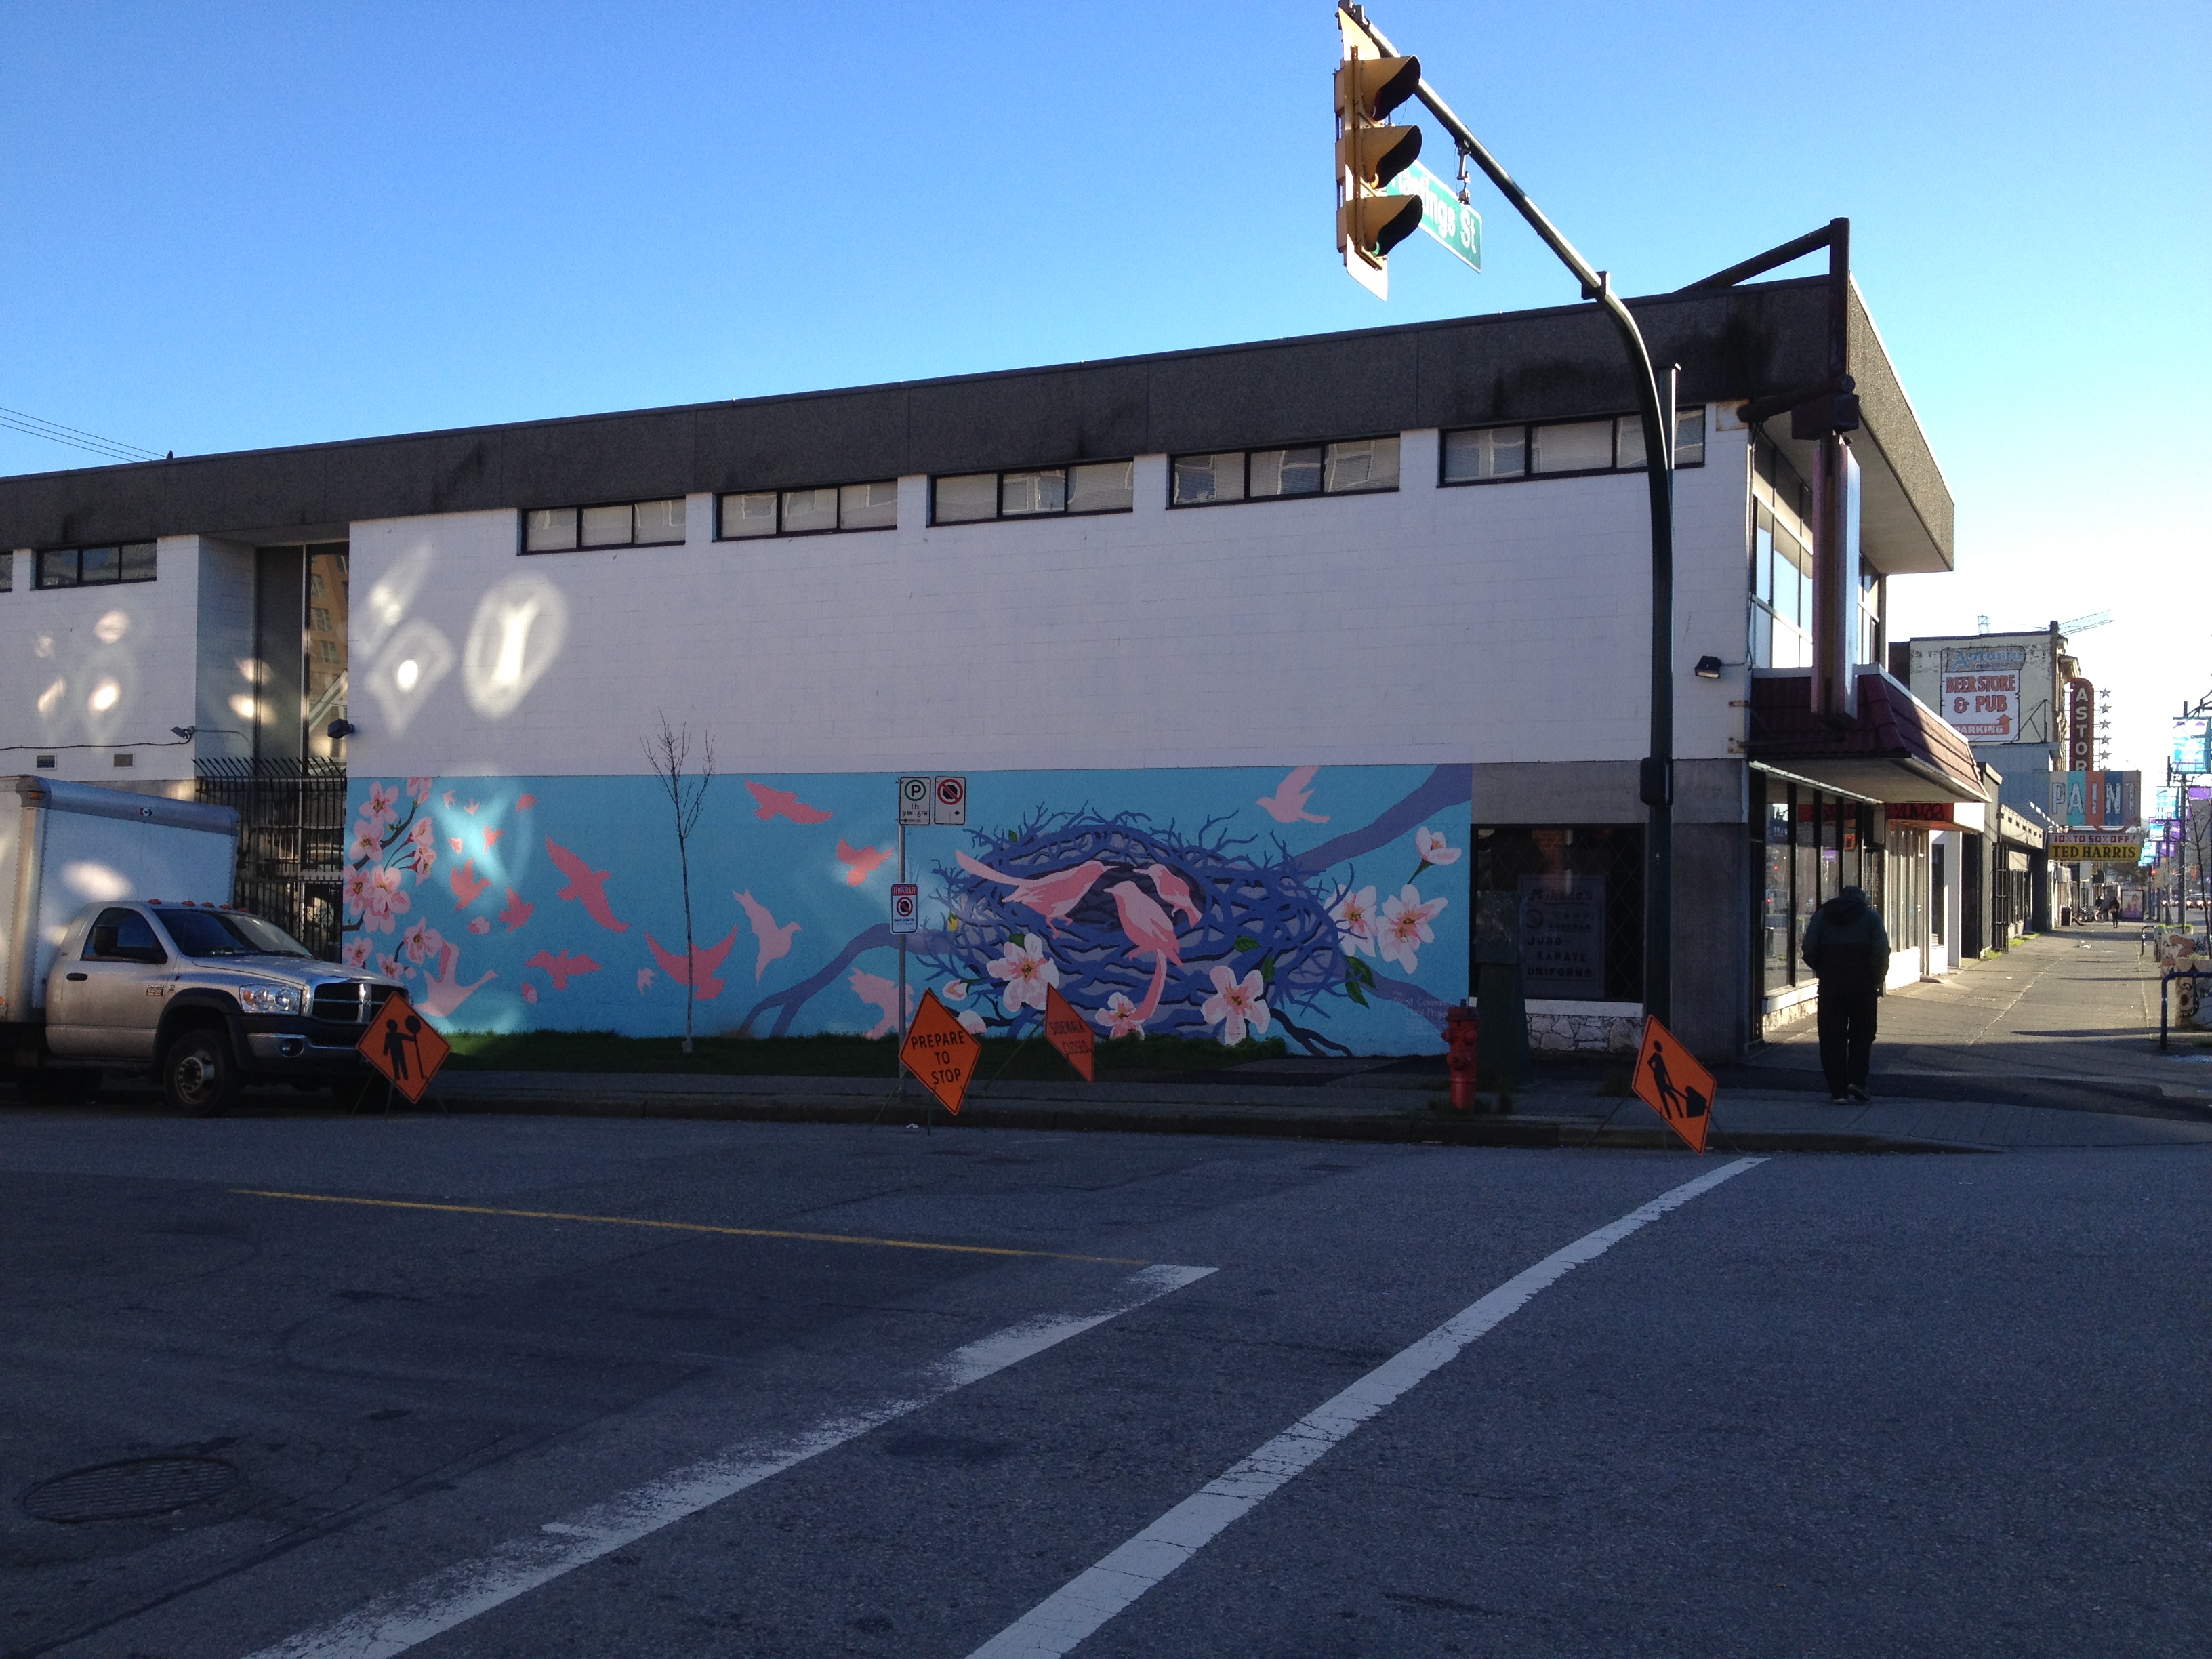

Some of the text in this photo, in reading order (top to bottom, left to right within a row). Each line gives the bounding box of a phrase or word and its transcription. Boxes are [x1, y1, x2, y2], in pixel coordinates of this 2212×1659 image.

[1460, 209, 1477, 253] St
[1946, 674, 2015, 693] BEER STORE
[1954, 695, 2007, 714] & PUB
[1954, 725, 2004, 734] PARKING
[2051, 781, 2136, 815] PAINT
[2074, 834, 2085, 843] TO
[2053, 846, 2136, 859] TED HARRIS
[893, 886, 916, 895] TEMPORARY
[1537, 951, 1587, 962] KARATE
[1527, 966, 1593, 978] UNIFORMS
[1427, 1006, 1448, 1020] Proje
[1049, 1020, 1086, 1035] SIDEWALK
[911, 1029, 966, 1050] PREPARE
[1063, 1040, 1089, 1055] CLOSED
[934, 1050, 951, 1065] TO
[930, 1068, 962, 1085] STOP
